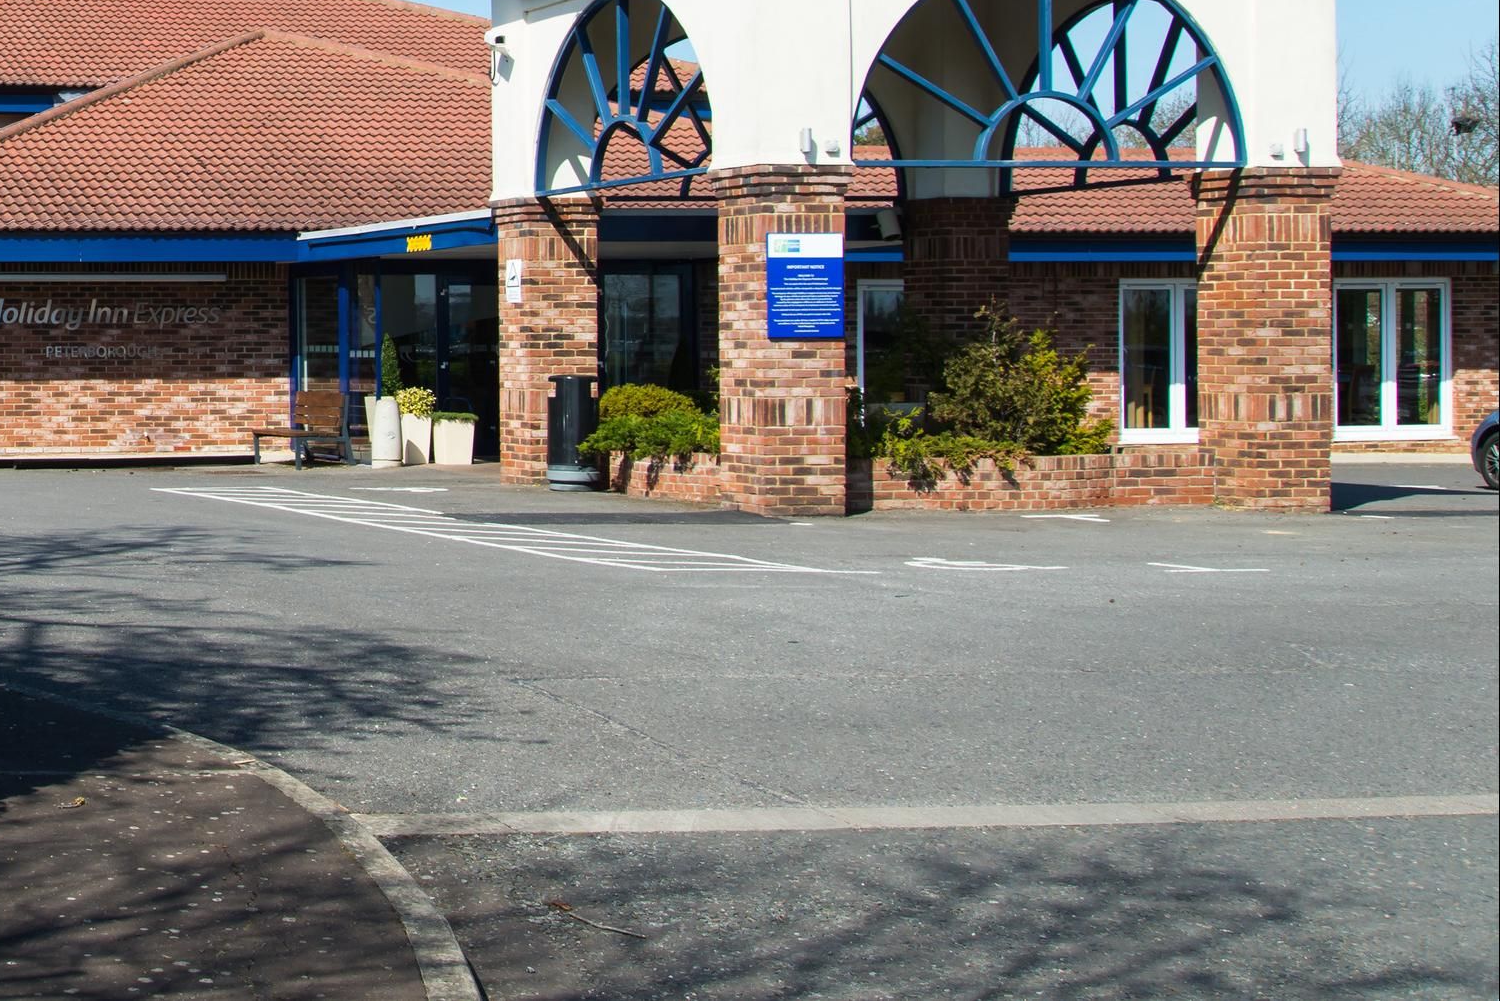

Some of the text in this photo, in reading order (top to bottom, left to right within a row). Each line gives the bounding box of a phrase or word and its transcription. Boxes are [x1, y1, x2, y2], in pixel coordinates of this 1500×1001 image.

[88, 298, 128, 324] Inn
[133, 302, 221, 330] Express
[45, 345, 158, 358] PETERBOROUGH
